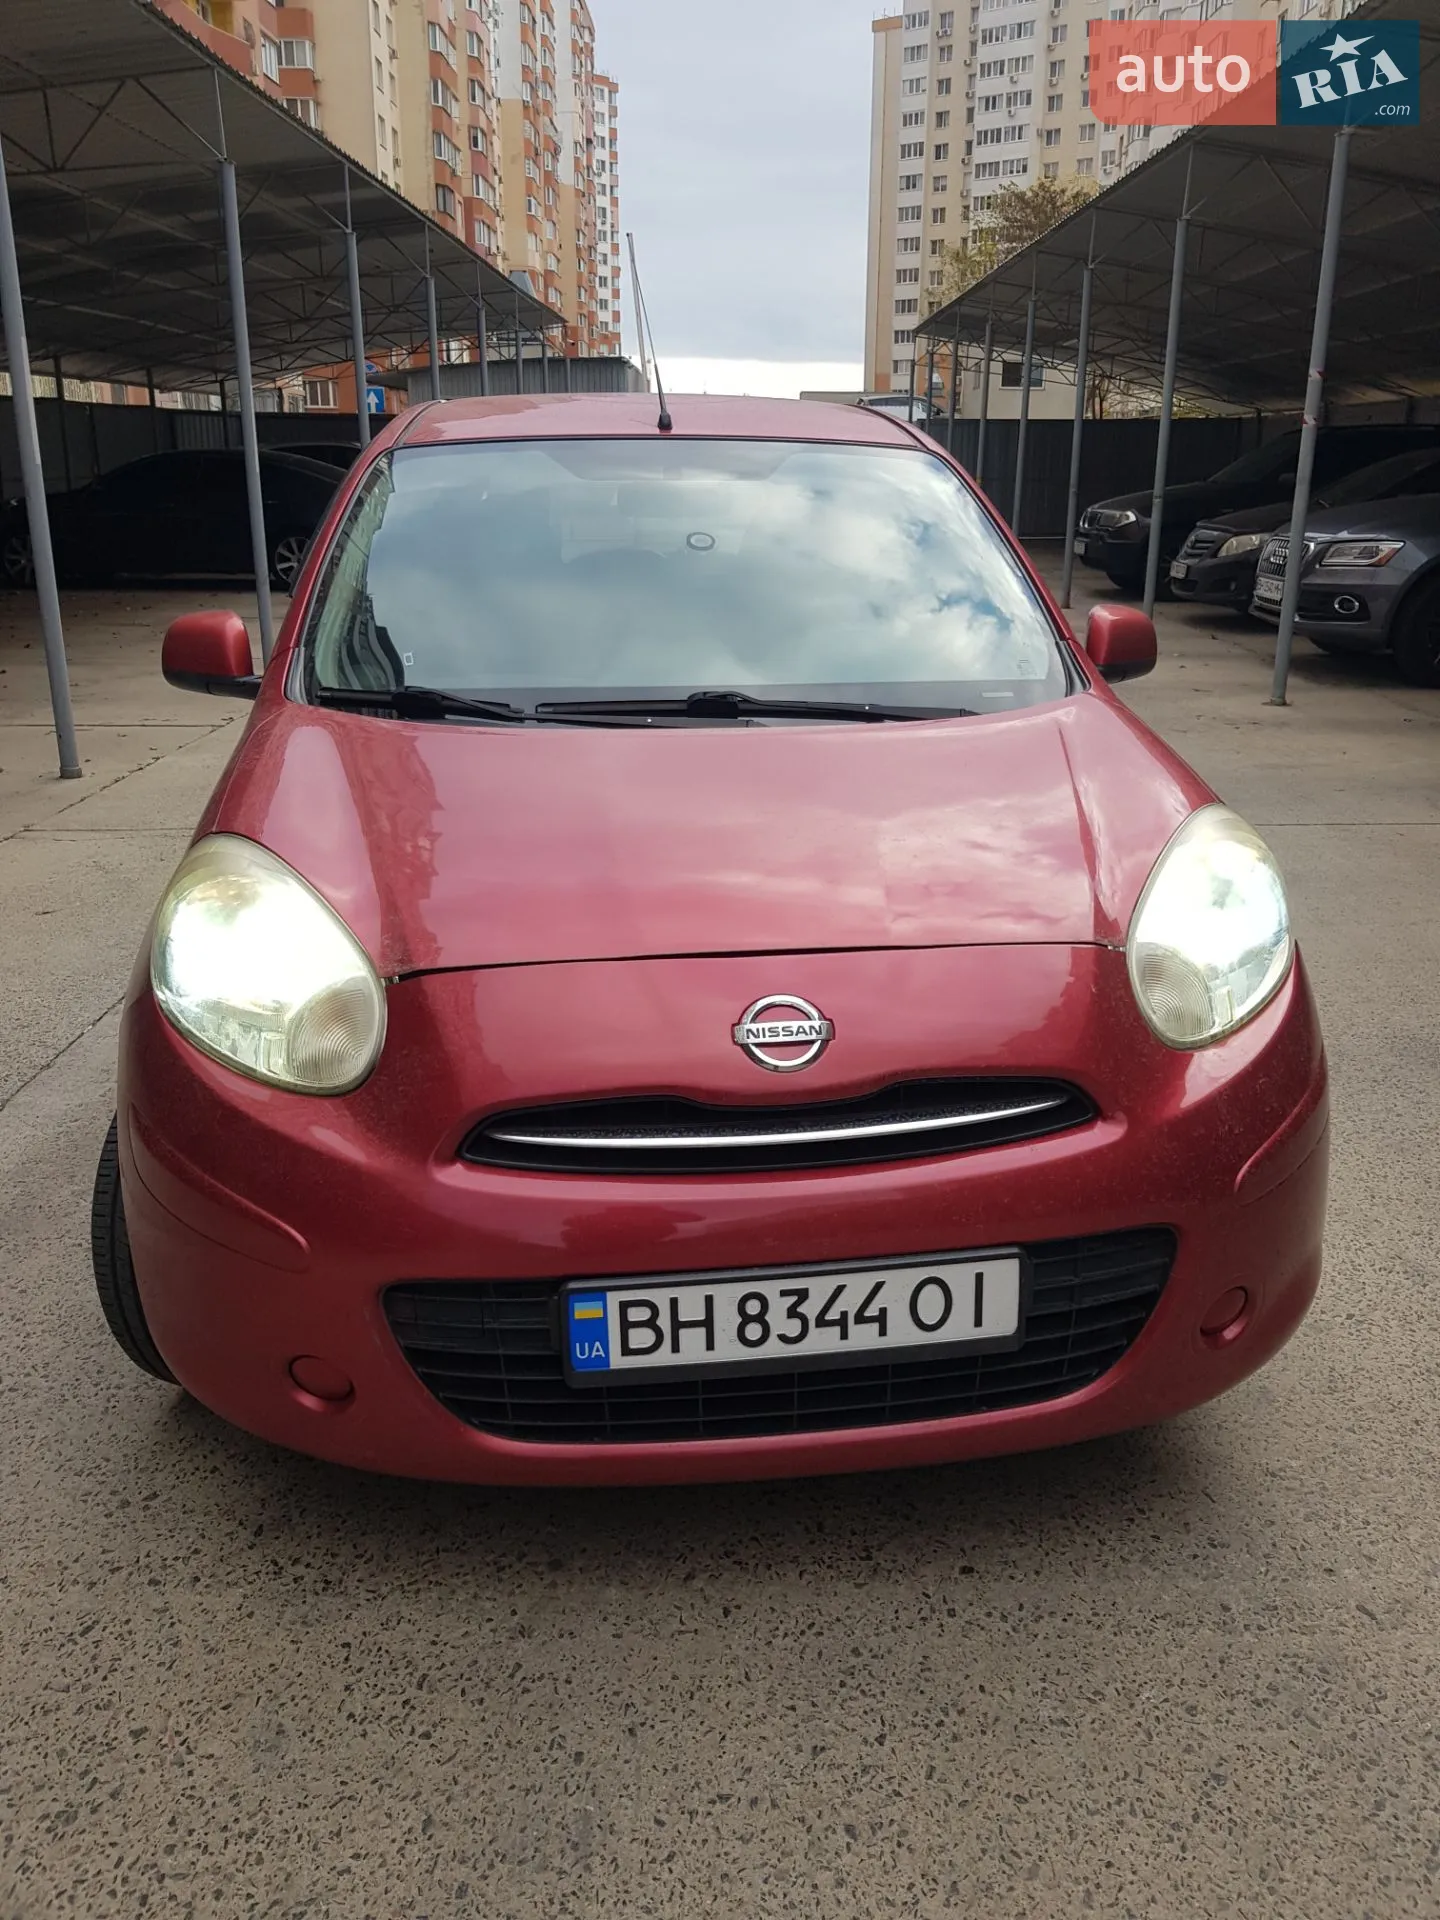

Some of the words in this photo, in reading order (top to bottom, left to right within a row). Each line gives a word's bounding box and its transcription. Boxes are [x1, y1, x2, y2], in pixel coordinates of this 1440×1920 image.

[745, 1025, 823, 1040] NISSAN
[618, 1293, 716, 1357] BH
[736, 1280, 888, 1348] 8344
[909, 1271, 985, 1333] OI
[575, 1341, 606, 1360] UA
